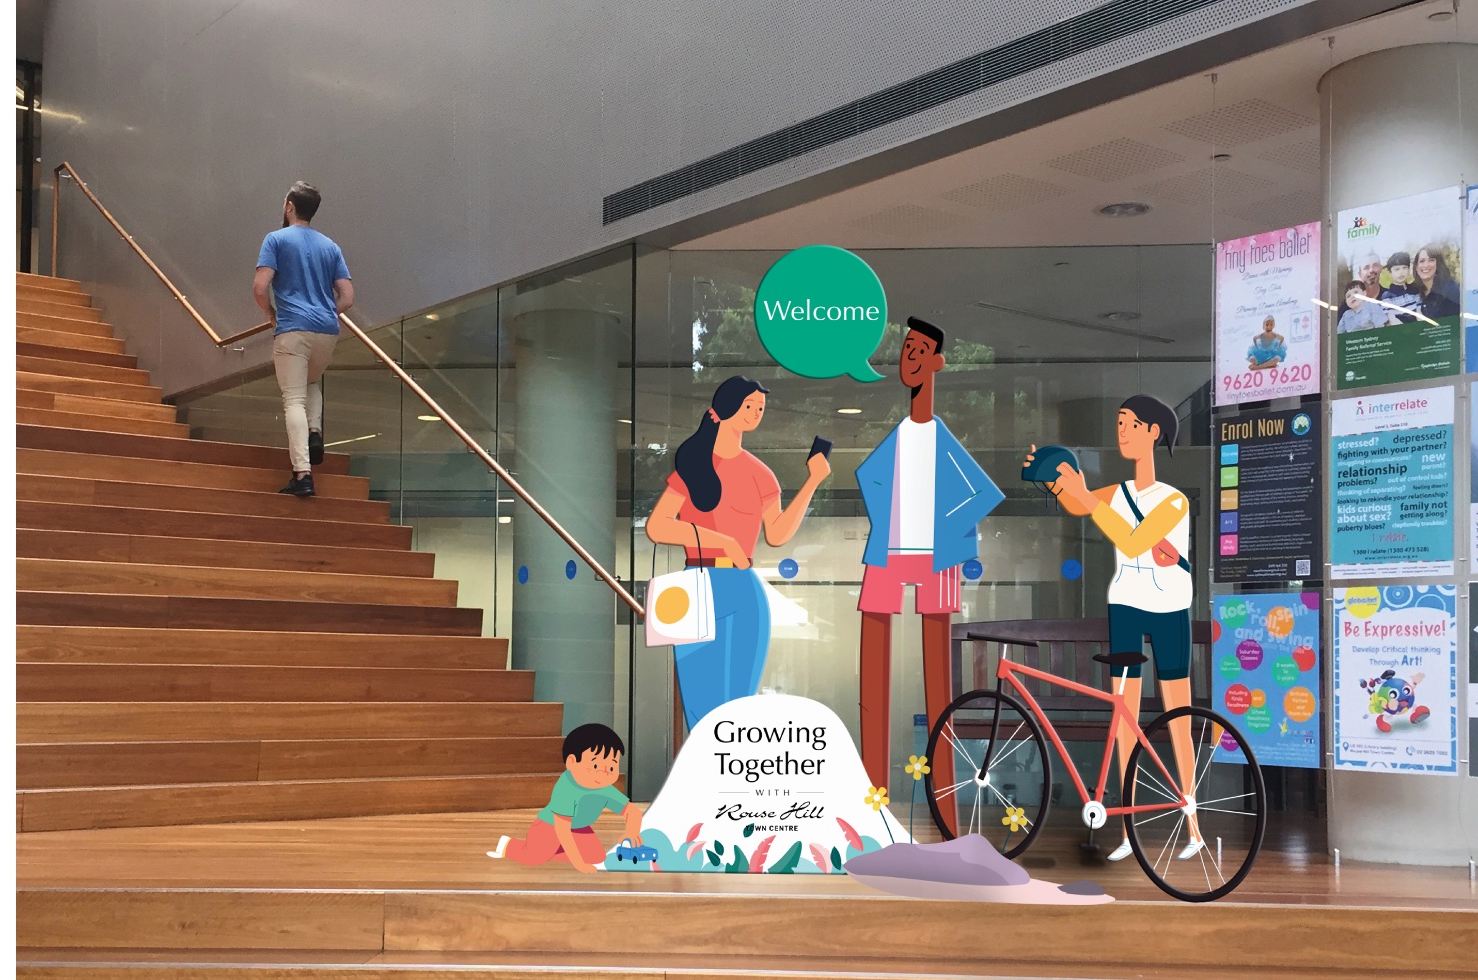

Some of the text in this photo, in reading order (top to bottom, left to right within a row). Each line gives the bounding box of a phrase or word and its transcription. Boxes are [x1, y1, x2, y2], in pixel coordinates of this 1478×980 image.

[1347, 224, 1381, 240] family
[763, 298, 880, 321] Welcome
[1223, 364, 1312, 392] 9620 9620
[1369, 399, 1428, 414] interrelate
[1222, 420, 1253, 442] Enrol
[1393, 430, 1447, 444] depressed?
[1337, 437, 1379, 450] stressed?
[1337, 441, 1447, 461] fighting with your partner?
[1422, 453, 1446, 463] new
[1337, 464, 1408, 479] relationship
[1421, 462, 1446, 471] parent?
[1337, 477, 1378, 489] problems?
[1337, 488, 1362, 496] thinking
[1370, 485, 1406, 495] separating?
[1408, 491, 1449, 501] relationship?
[1337, 504, 1392, 514] kids curious
[1400, 500, 1448, 511] family not
[1337, 511, 1392, 524] about sex?
[1400, 510, 1448, 520] getting along?
[1337, 523, 1363, 533] puberty
[1234, 627, 1263, 641] and
[1344, 620, 1446, 640] Be Expressive!
[1352, 645, 1441, 655] Develop Critical thinking
[1369, 655, 1422, 668] Through Art!
[714, 720, 827, 751] Growing
[714, 751, 826, 783] Together
[715, 801, 824, 821] Rouse Hill
